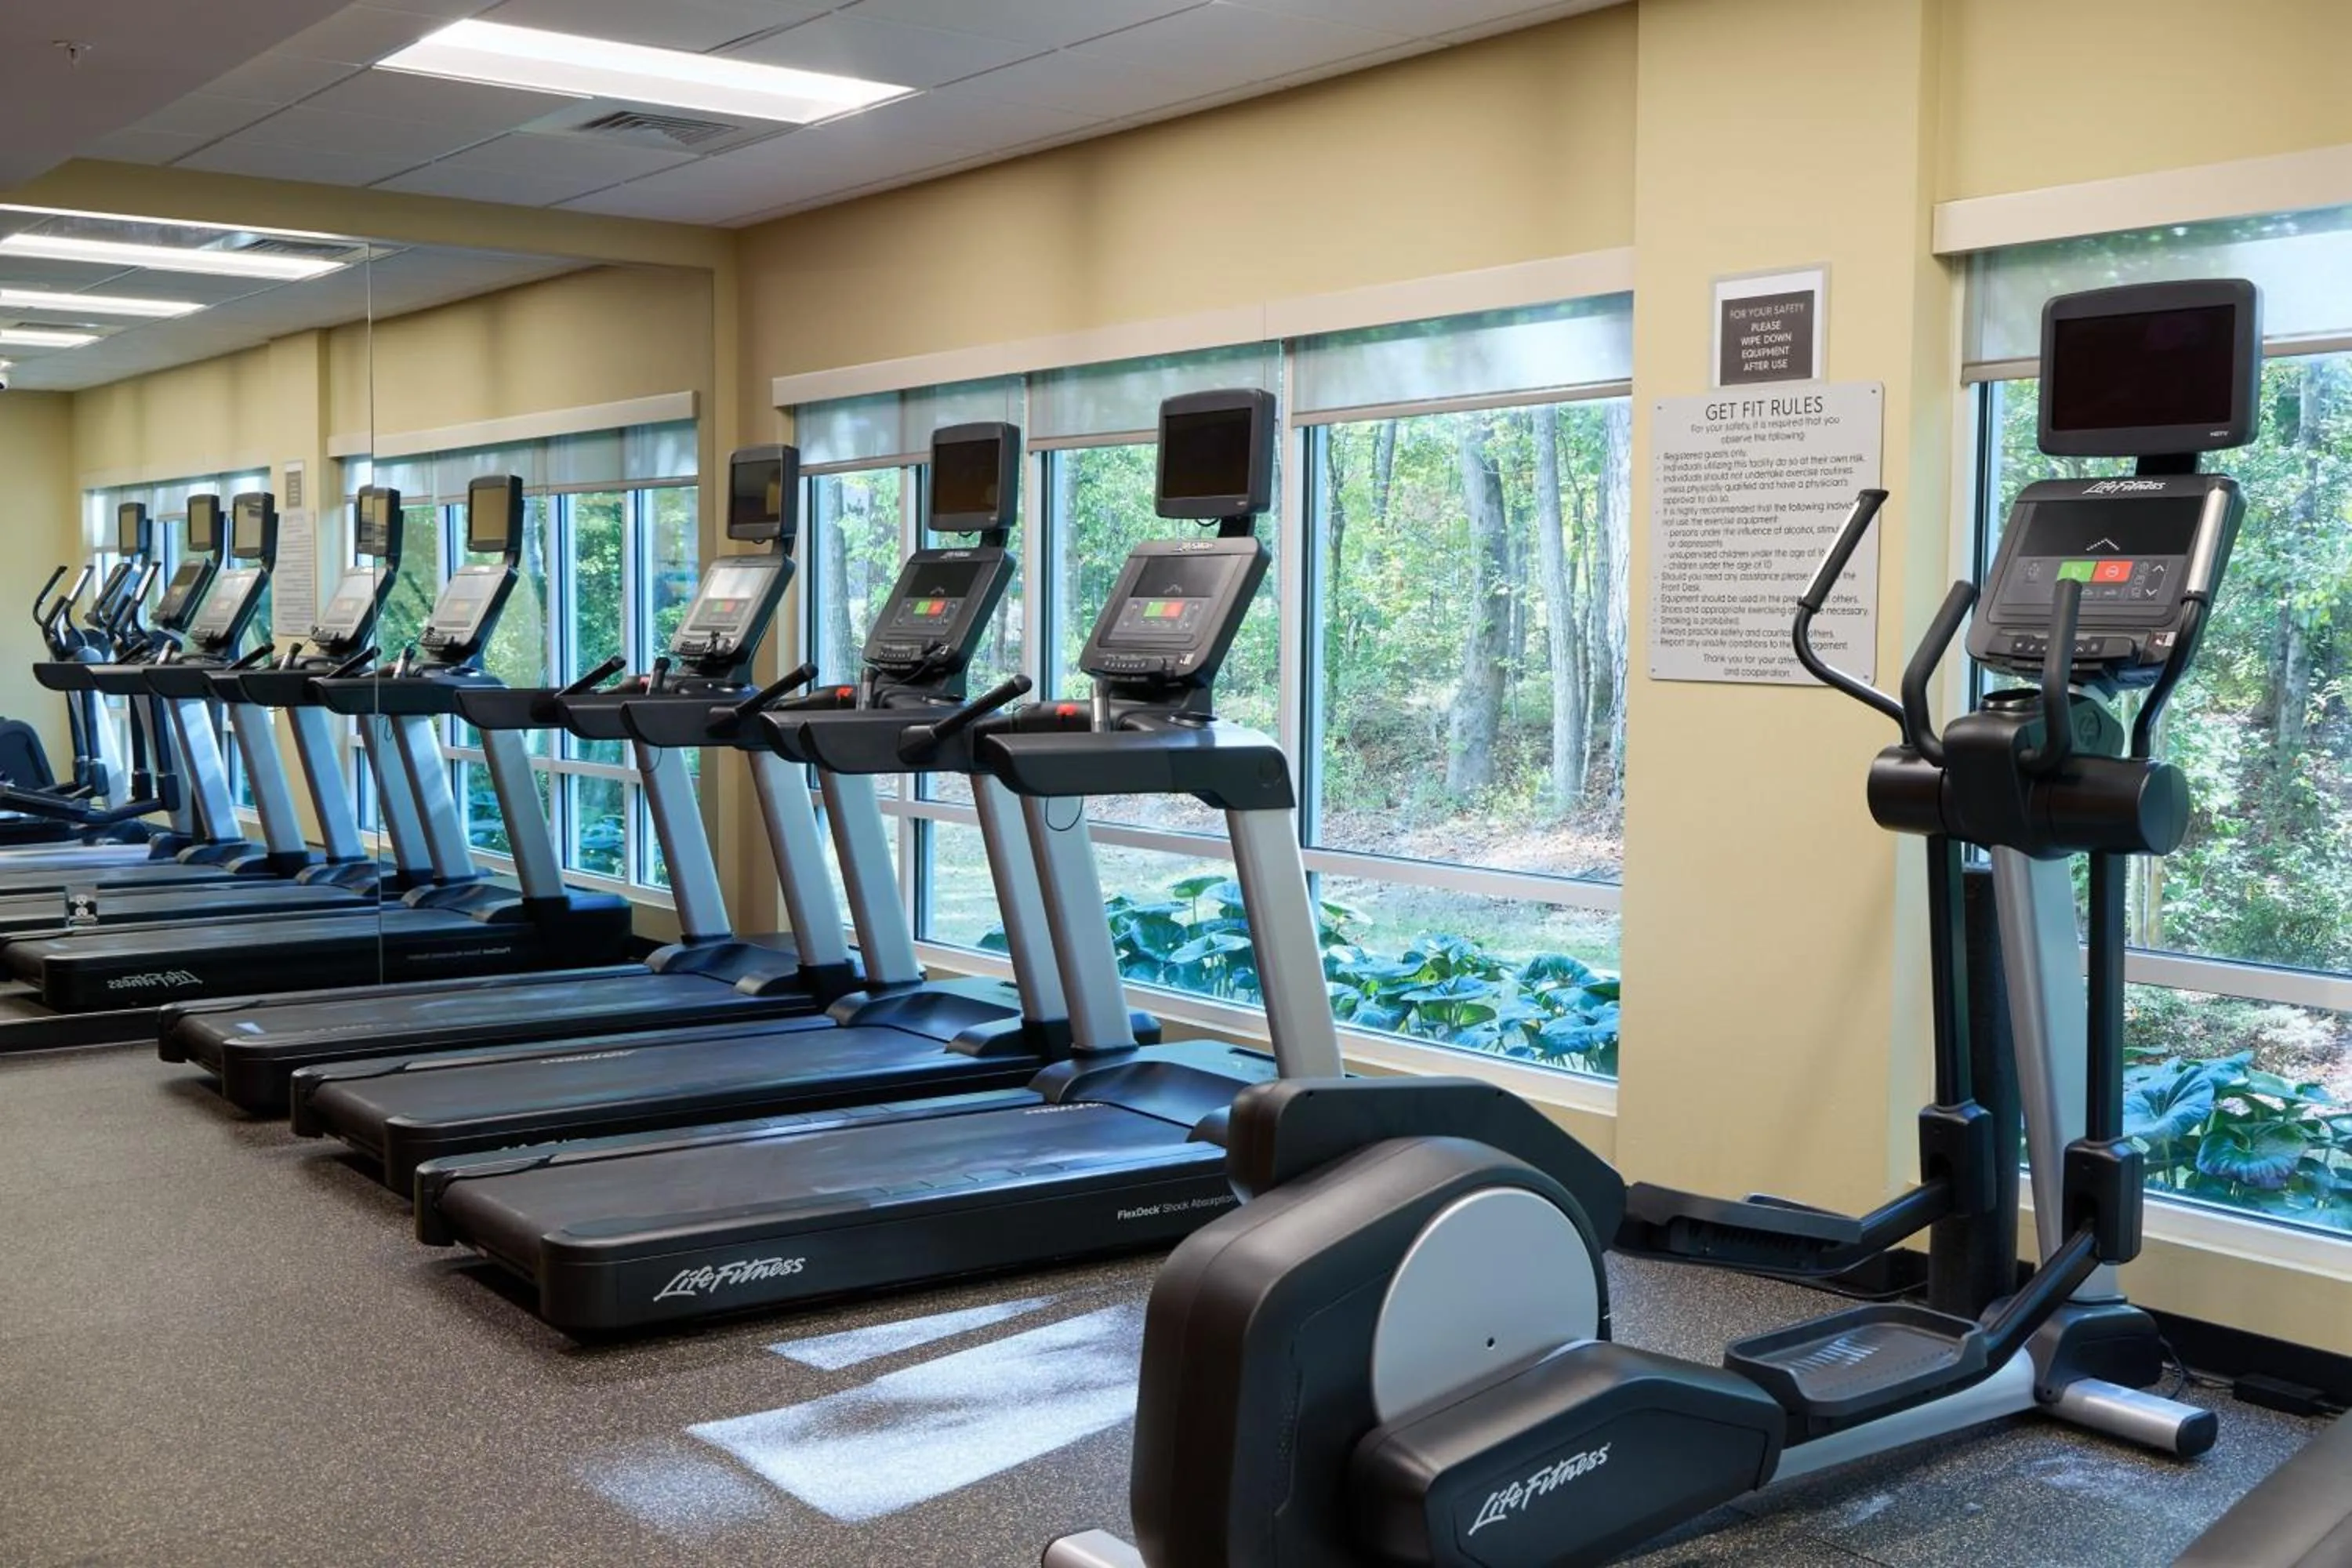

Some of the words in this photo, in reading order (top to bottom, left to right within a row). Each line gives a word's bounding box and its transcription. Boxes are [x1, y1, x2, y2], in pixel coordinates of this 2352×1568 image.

[1730, 309, 1747, 319] FOR
[1748, 307, 1772, 318] YOUR
[1773, 303, 1805, 315] SAFETY
[1751, 320, 1781, 332] PLEASE
[1740, 336, 1762, 347] WIPE
[1764, 332, 1792, 344] DOWN
[1741, 346, 1790, 359] EQUIPMENT
[1744, 360, 1769, 372] AFTER
[1771, 358, 1788, 370] USE
[1705, 401, 1737, 421] GET
[1742, 399, 1765, 418] FIT
[1770, 395, 1823, 416] RULES
[1691, 424, 1704, 433] For
[1705, 424, 1722, 434] your
[1768, 417, 1802, 430] required
[1804, 416, 1821, 425] that
[1824, 416, 1839, 426] you
[1720, 434, 1752, 443] observe
[1664, 451, 1703, 462] Registered
[1704, 449, 1728, 459] guests
[1663, 462, 1702, 471] Individuals
[1704, 460, 1731, 471] utilizing
[1749, 458, 1773, 469] facility
[1775, 457, 1786, 466] do
[1810, 455, 1828, 464] their
[1663, 473, 1701, 482] Individuals
[1704, 471, 1728, 480] should
[1744, 469, 1784, 478] undertake
[1786, 467, 1818, 477] exercise
[1686, 483, 1721, 494] physically
[1725, 481, 1756, 492] qualified
[1759, 481, 1773, 489] and
[1776, 480, 1795, 488] have
[1662, 495, 1694, 506] approval
[1677, 506, 1697, 516] highly
[1698, 504, 1755, 514] recommended
[1756, 503, 1771, 512] that
[1788, 502, 1824, 513] following
[1669, 529, 1697, 538] persons
[1723, 527, 1735, 535] the
[1737, 526, 1772, 535] influence
[1678, 539, 1722, 549] depressants
[1668, 550, 1717, 560] unsupervised
[1718, 549, 1748, 557] children
[1789, 550, 1805, 558] age
[1699, 561, 1720, 569] under
[1736, 561, 1752, 570] age
[1688, 573, 1701, 582] you
[1723, 573, 1737, 582] any
[1780, 572, 1807, 581] please
[1842, 571, 1855, 579] the
[1661, 594, 1698, 604] Equipment
[1700, 605, 1745, 615] appropriate
[1748, 605, 1786, 615] exercising
[1660, 615, 1691, 626] Smoking
[1660, 626, 1686, 637] Always
[1688, 627, 1719, 637] practice
[1720, 628, 1743, 637] safety
[1744, 628, 1760, 637] and
[1660, 637, 1684, 648] Report
[1686, 639, 1700, 648] any
[1729, 639, 1769, 648] conditions
[1163, 1202, 1190, 1214] Shock
